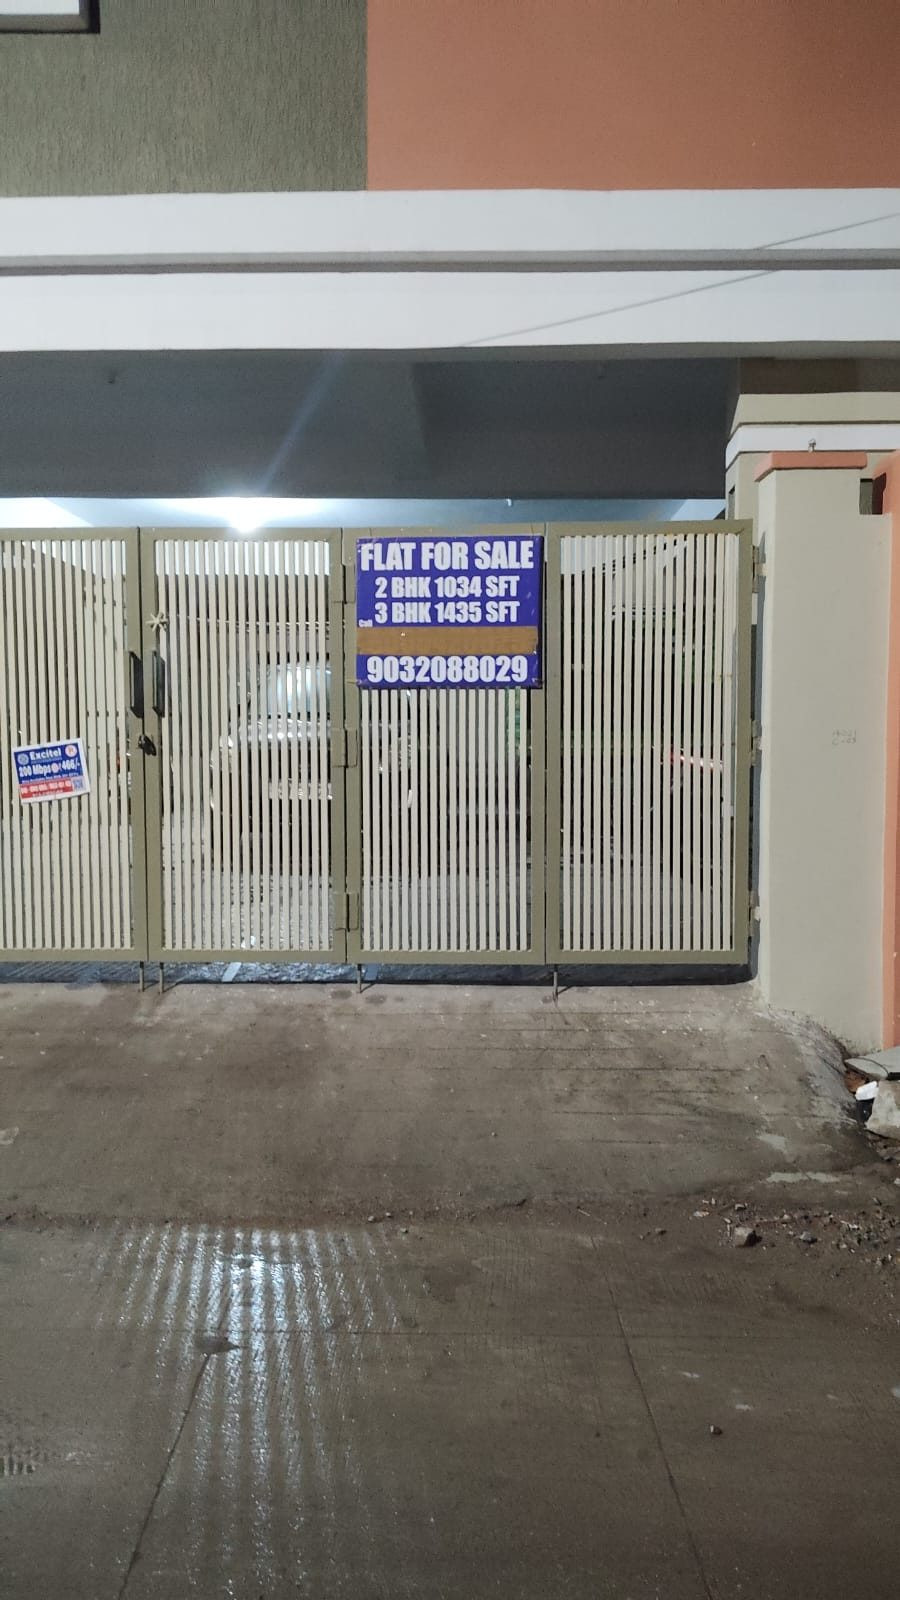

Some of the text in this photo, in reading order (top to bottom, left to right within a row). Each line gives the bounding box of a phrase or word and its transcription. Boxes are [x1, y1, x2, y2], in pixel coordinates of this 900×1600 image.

[360, 541, 534, 571] FLAT FOR SALE
[374, 575, 520, 598] 2 BHK 1034 SFT
[374, 601, 520, 623] 3 BHK 1435 SFT
[366, 655, 528, 683] 9032088029
[29, 747, 62, 760] Excitel
